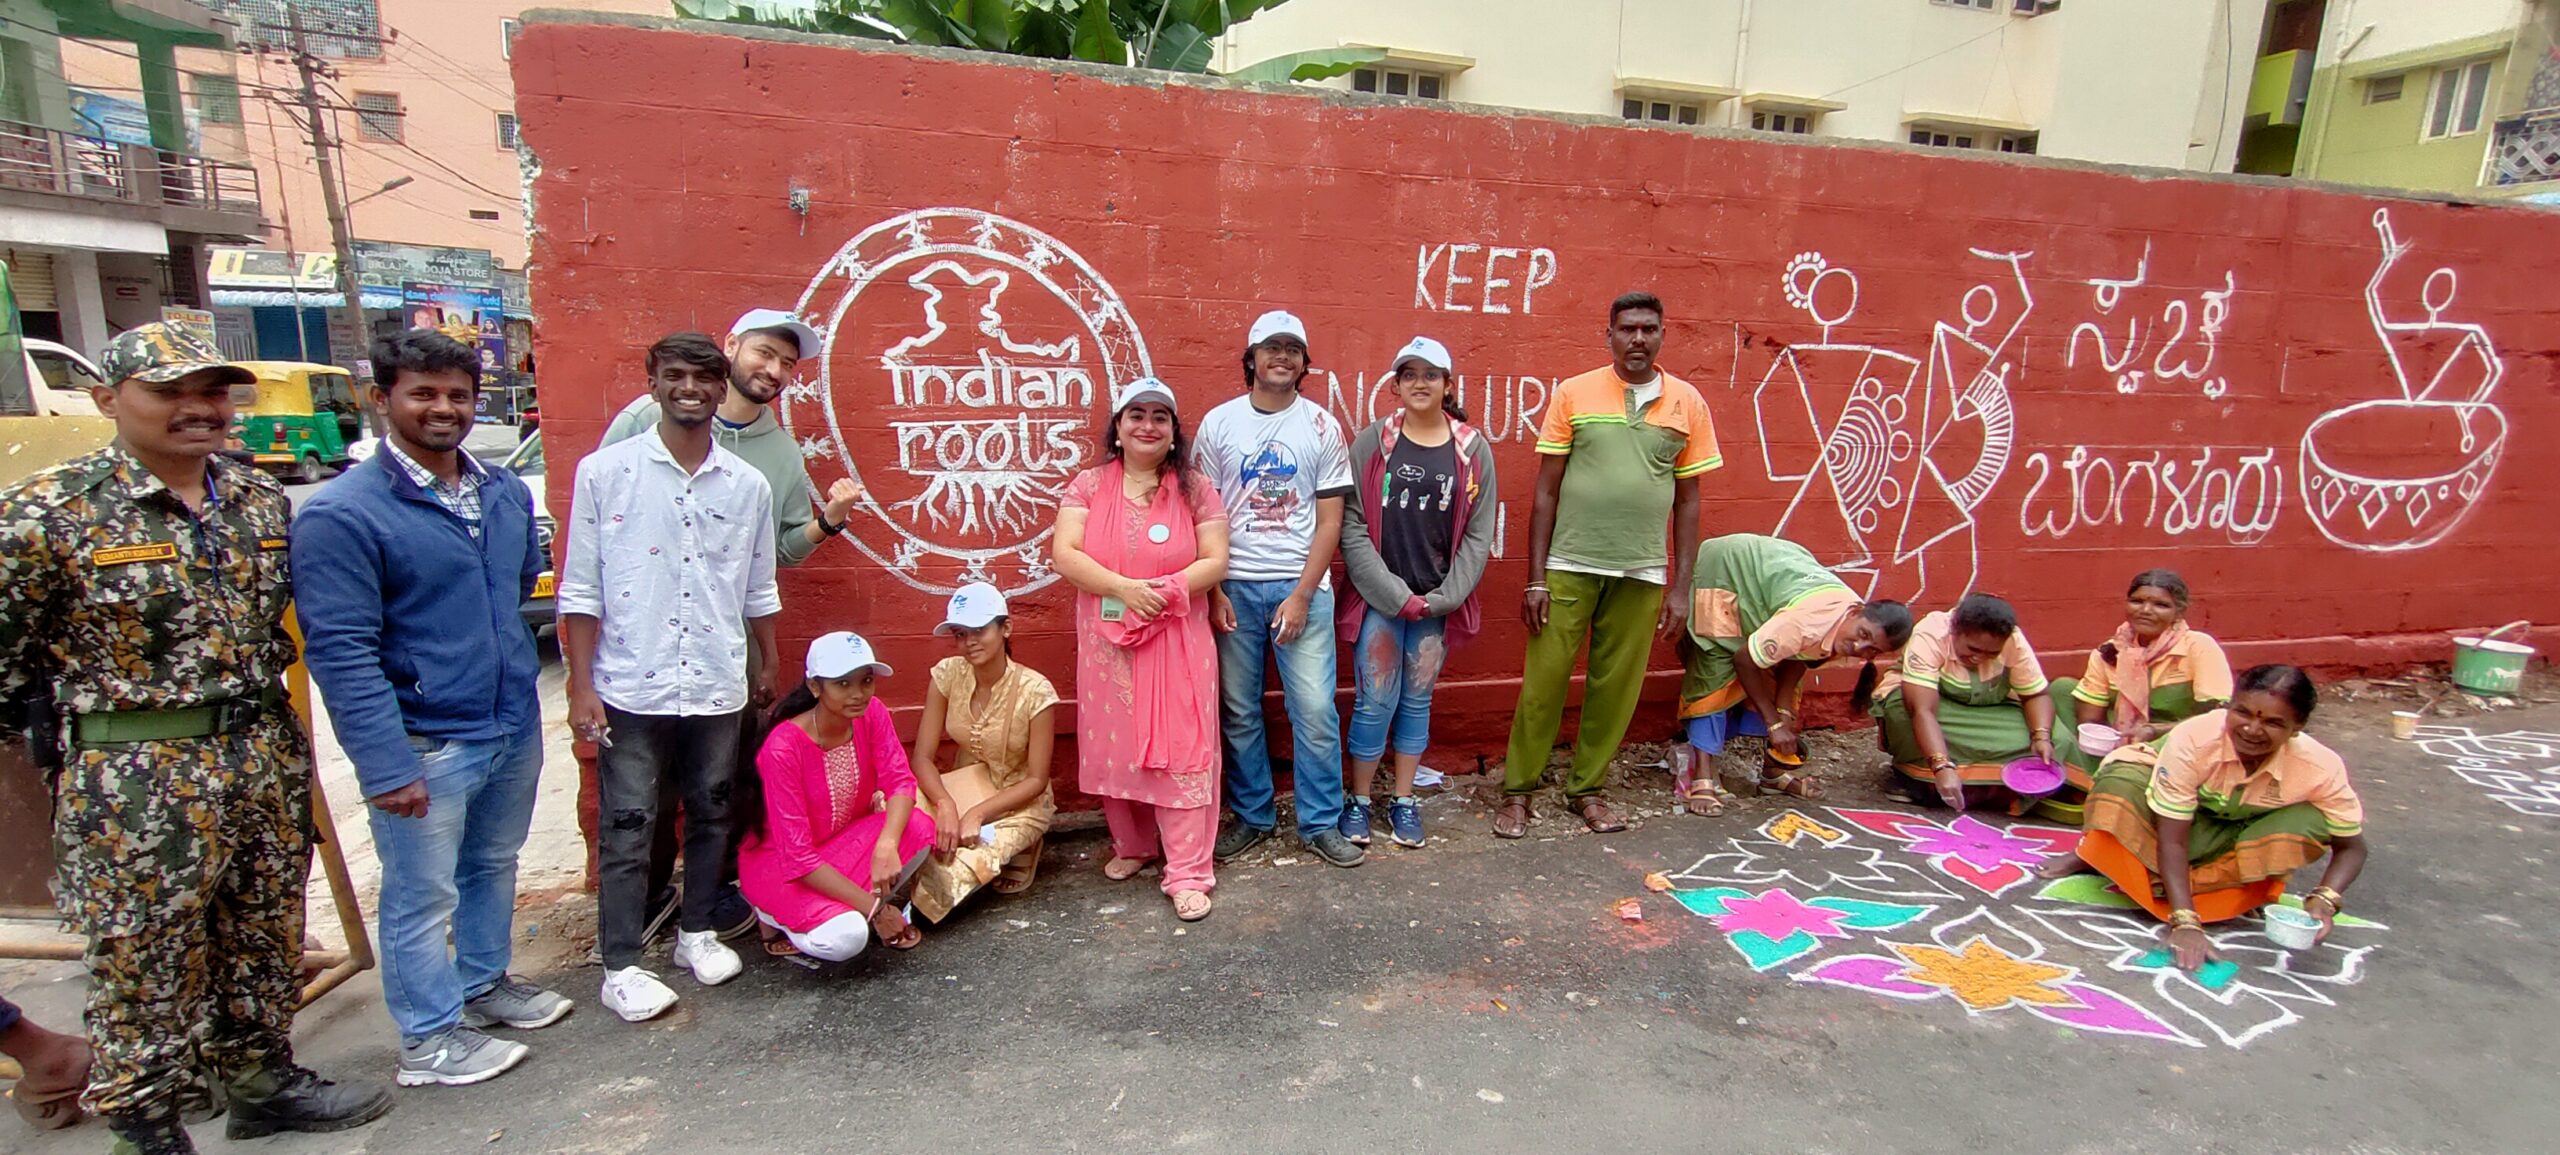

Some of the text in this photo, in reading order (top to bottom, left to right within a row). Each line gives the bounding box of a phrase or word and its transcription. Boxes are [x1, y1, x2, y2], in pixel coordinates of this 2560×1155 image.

[453, 267, 488, 279] STORE
[1414, 242, 1557, 314] KEEP
[896, 411, 1083, 476] roots
